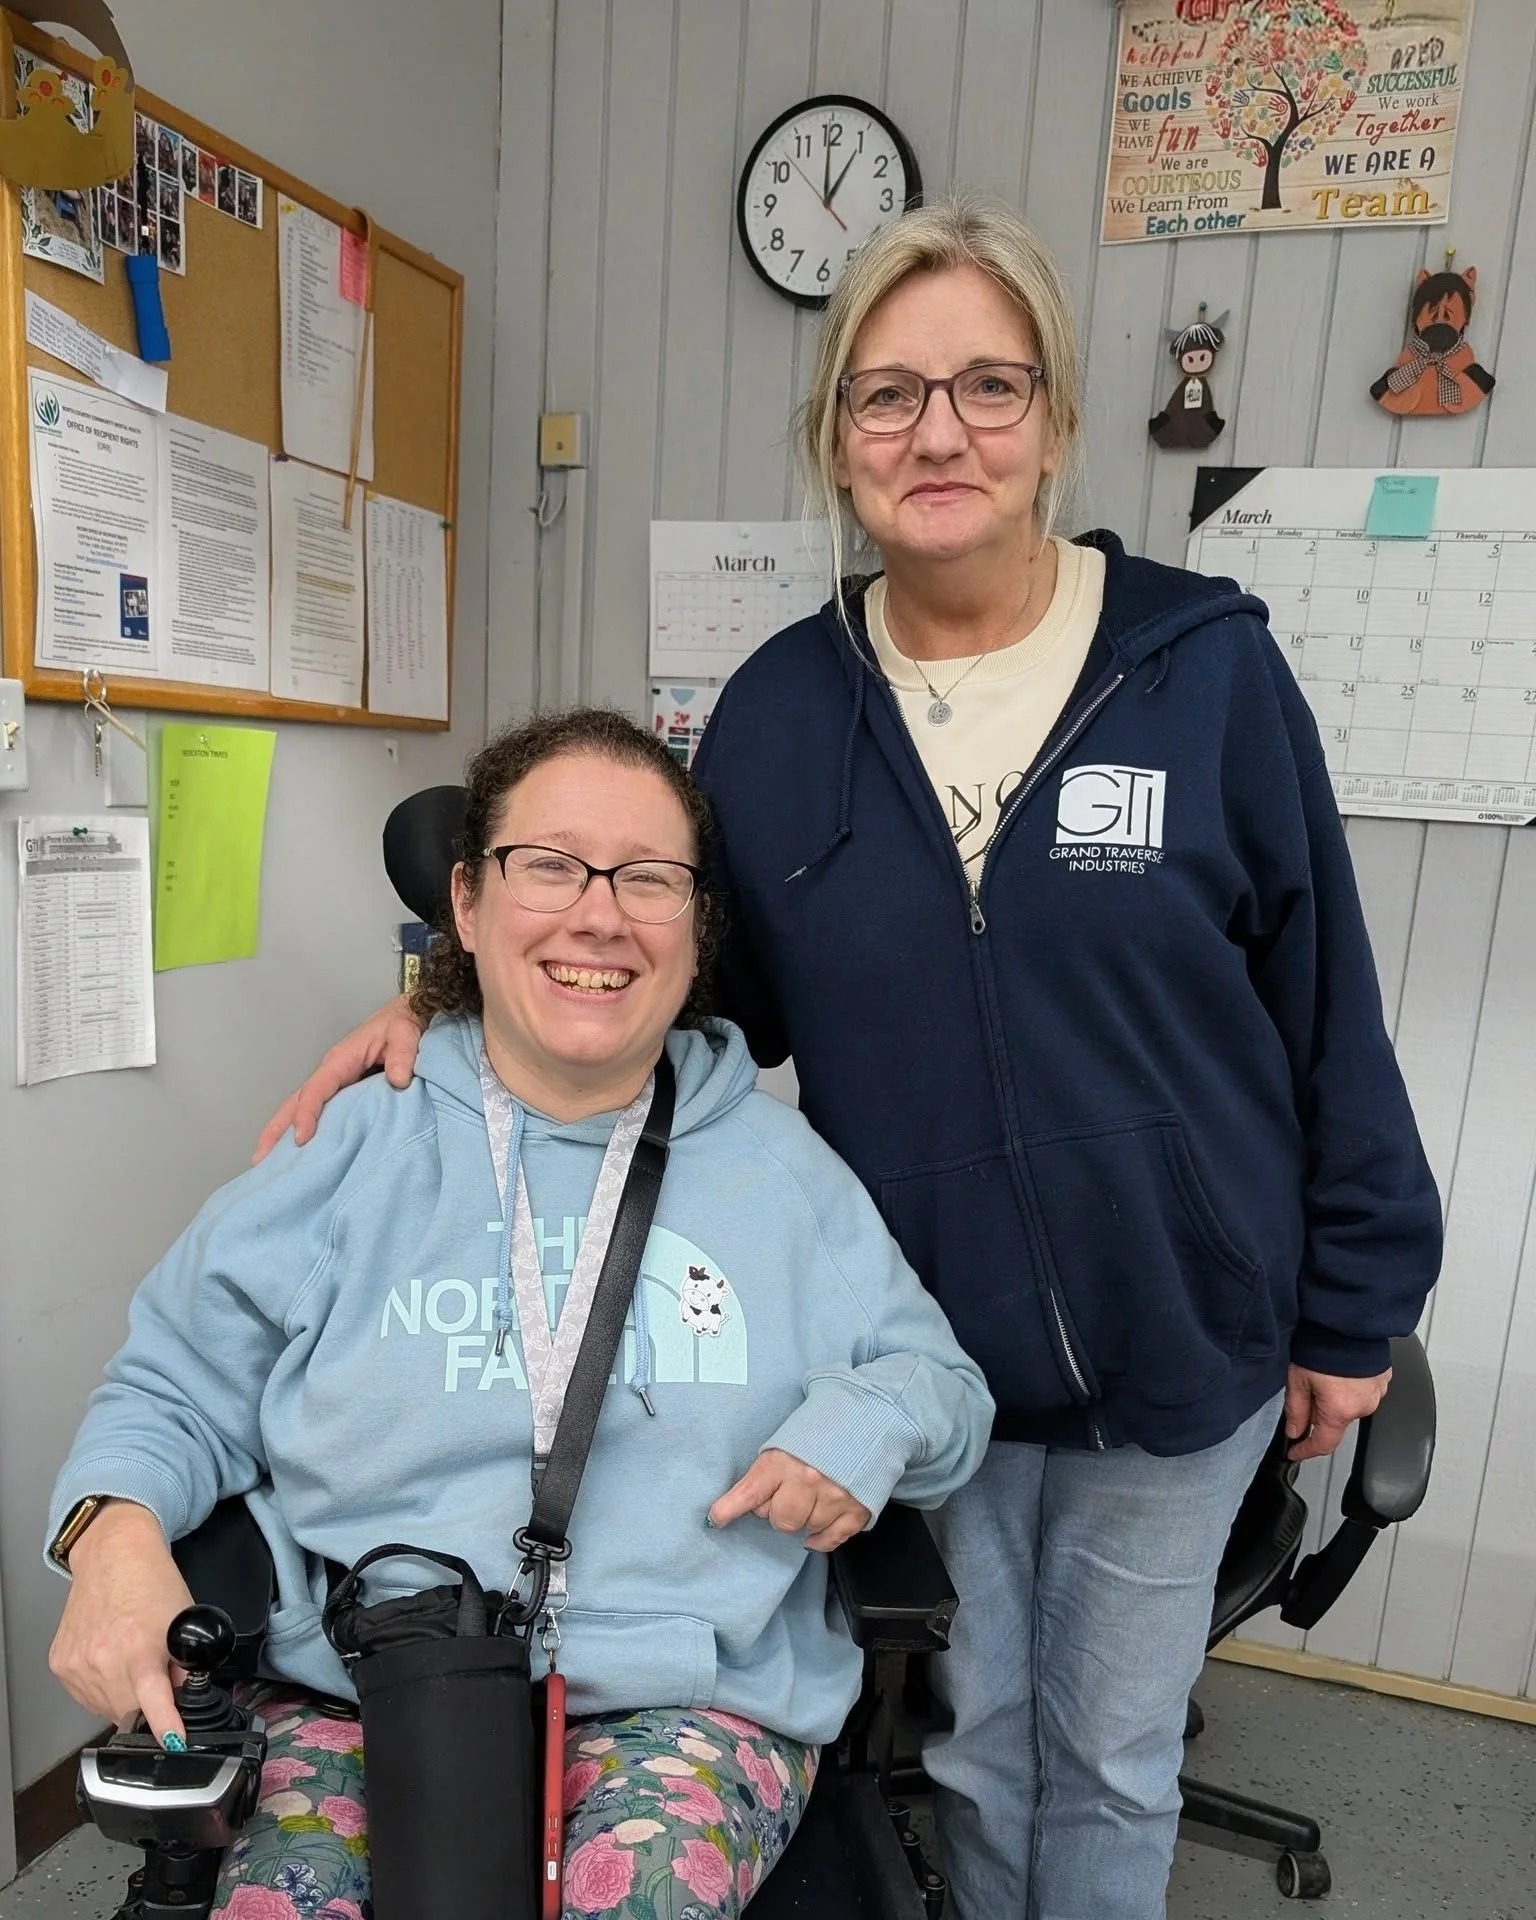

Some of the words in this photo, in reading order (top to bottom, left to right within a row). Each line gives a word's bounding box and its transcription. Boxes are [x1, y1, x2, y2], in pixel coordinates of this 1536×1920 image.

[1126, 31, 1207, 68] helpful
[1120, 74, 1138, 88] WE
[1142, 70, 1203, 87] ACHIEVE
[1367, 64, 1457, 94] SUCCESSFUL
[1122, 86, 1191, 113] Goals
[1379, 97, 1399, 110] We
[1406, 93, 1439, 108] work
[822, 123, 843, 147] 12
[1128, 119, 1150, 132] WE
[1355, 109, 1445, 146] Together
[795, 135, 812, 158] 11
[857, 131, 864, 154] 1
[1118, 135, 1154, 149] HAVE
[1148, 114, 1200, 164] fun
[772, 161, 790, 184] 10
[873, 155, 888, 179] 2
[1161, 157, 1180, 170] We
[1186, 158, 1208, 170] are
[1325, 154, 1358, 176] WE
[1365, 149, 1411, 175] ARE
[1419, 147, 1436, 171] A
[1122, 170, 1242, 197] COURTEOUS
[763, 193, 777, 217] 9
[879, 188, 893, 213] 3
[1110, 200, 1135, 214] We
[1139, 198, 1182, 213] Learn
[1187, 195, 1229, 210] From
[1311, 188, 1430, 220] Team
[1146, 213, 1188, 235] Each
[1194, 211, 1246, 229] other
[770, 228, 784, 251] 8
[790, 250, 805, 273] 7
[816, 258, 830, 282] 6
[66, 420, 86, 433] OFFICE
[85, 425, 93, 434] OF
[93, 428, 120, 442] RECIPIENT
[120, 435, 139, 448] RIGHTS
[1222, 509, 1273, 524] March
[1251, 540, 1256, 550] 1
[1309, 541, 1316, 551] 2
[1370, 542, 1376, 553] 3
[1430, 543, 1437, 554] 4
[1492, 544, 1500, 555] 5
[1456, 532, 1488, 540] Thursday
[712, 555, 775, 572] March
[1302, 589, 1310, 598] 9
[1356, 590, 1369, 600] 10
[1416, 592, 1429, 603] 11
[1478, 592, 1492, 603] 12
[1290, 634, 1304, 645] 16
[1350, 636, 1362, 647] 17
[1409, 638, 1422, 650] 18
[1471, 640, 1484, 651] 19
[1341, 683, 1355, 693] 24
[1401, 685, 1415, 696] 25
[1461, 688, 1476, 699] 26
[1524, 690, 1536, 701] 27
[1334, 729, 1348, 740] 31
[1057, 769, 1154, 847] GTI
[1049, 847, 1101, 860] GRAND
[1105, 847, 1165, 864] TRAVERSE
[1069, 860, 1146, 875] INDUSTRIES
[380, 1274, 571, 1338] NORT
